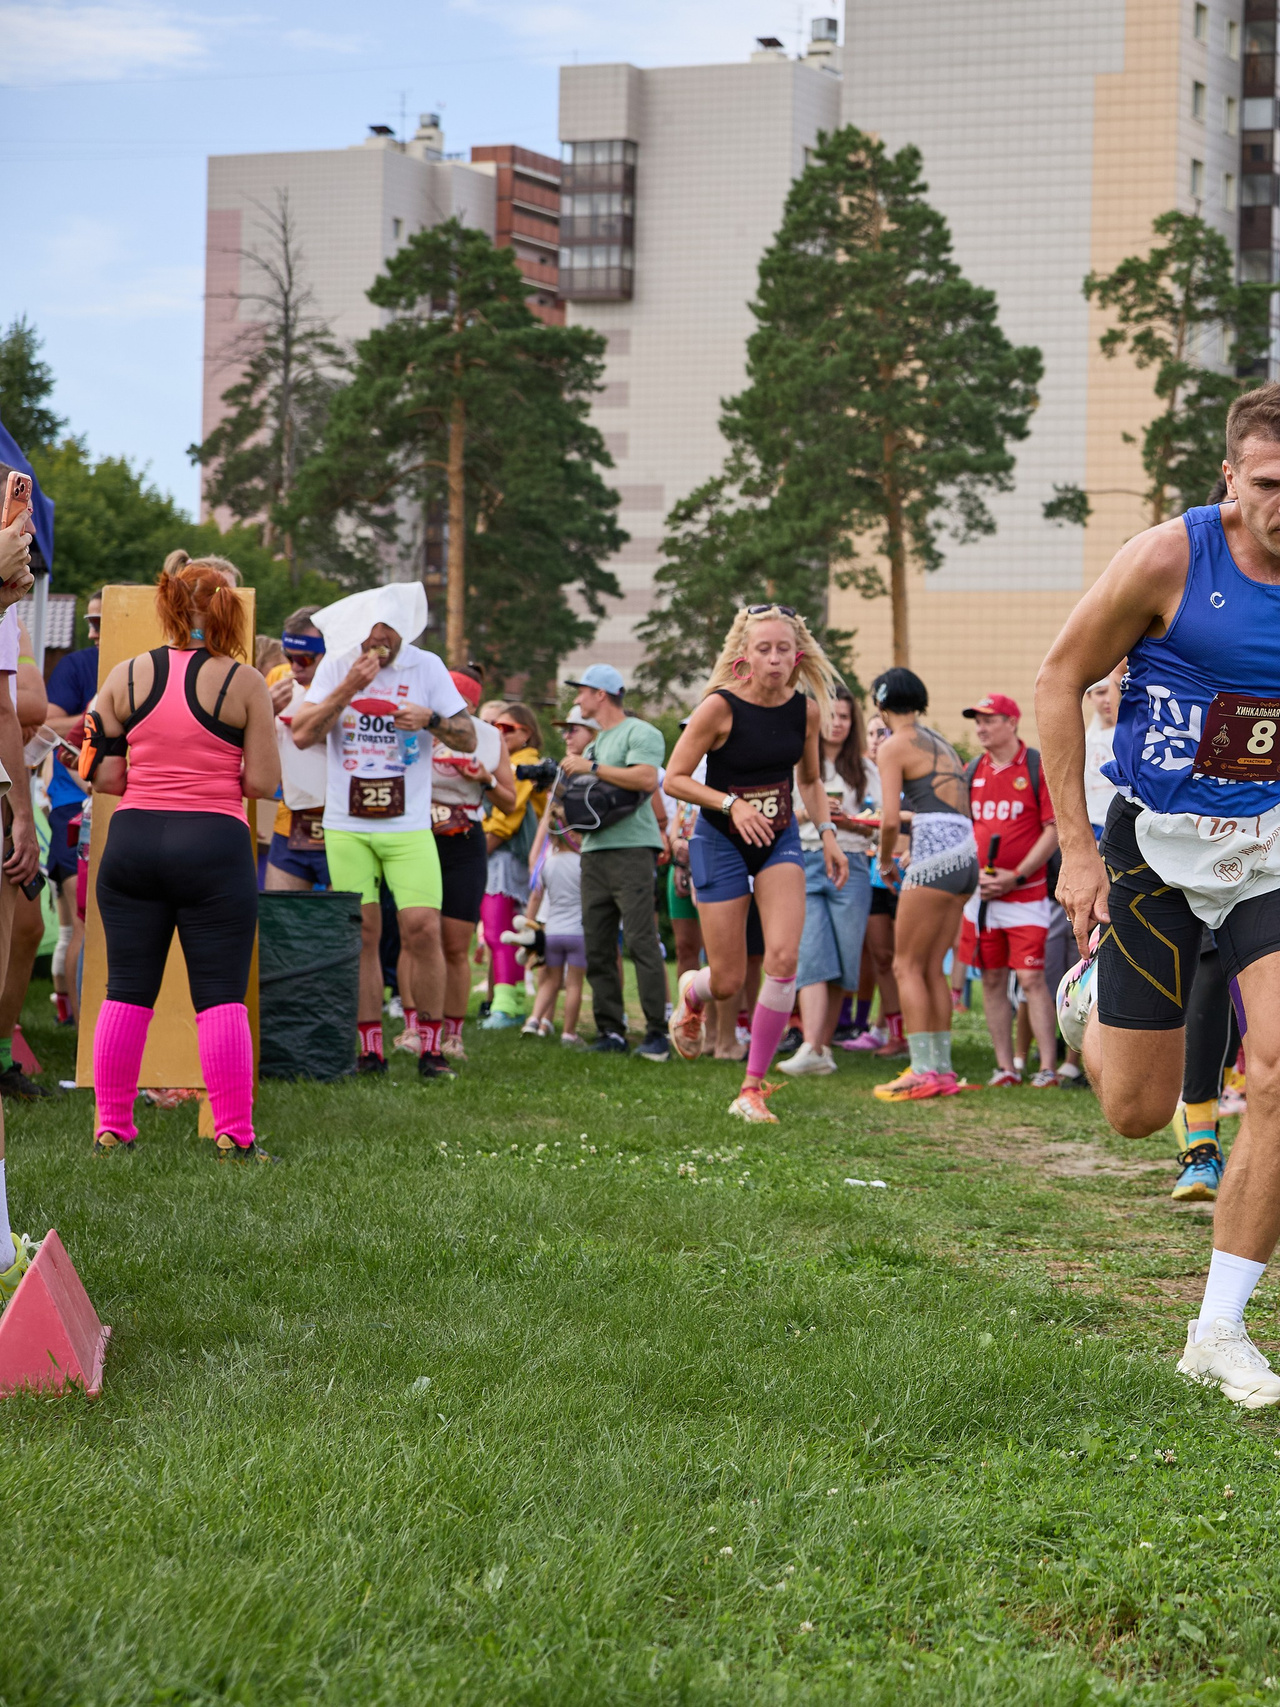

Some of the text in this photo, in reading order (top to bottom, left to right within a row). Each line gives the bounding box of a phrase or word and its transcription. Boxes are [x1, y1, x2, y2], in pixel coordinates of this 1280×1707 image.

[1235, 705, 1280, 718] ХИНКАЛЬНАЯ
[1246, 719, 1277, 755] 8
[362, 787, 392, 807] 25
[971, 800, 1024, 820] СССР
